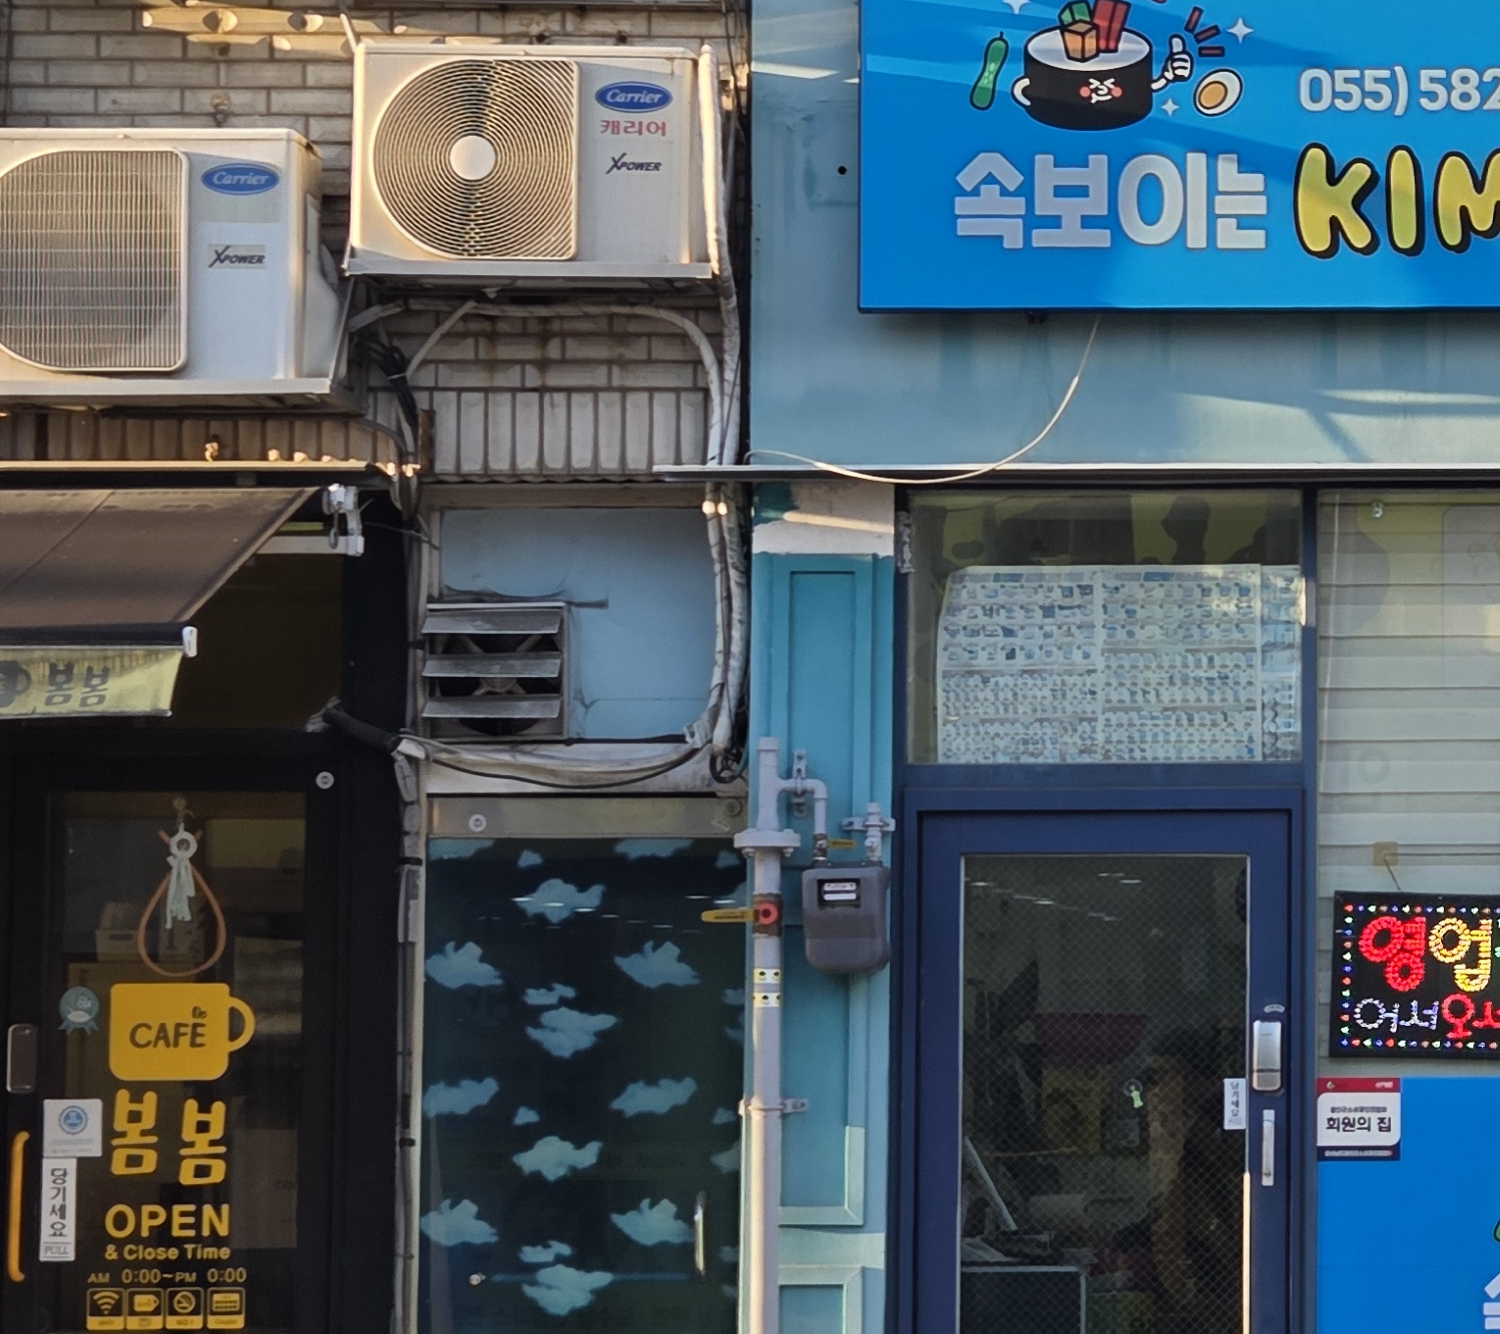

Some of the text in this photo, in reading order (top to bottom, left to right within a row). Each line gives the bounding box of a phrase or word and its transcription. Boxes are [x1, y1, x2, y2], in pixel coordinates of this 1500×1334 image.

[606, 89, 663, 104] Carrier
[600, 119, 667, 137] 캐리어
[212, 171, 270, 185] Carrier
[953, 151, 1268, 250] 속보이는
[44, 662, 110, 707] 봄봄
[1325, 1116, 1392, 1133] 회원의 집
[111, 1088, 232, 1186] 봄봄
[49, 1168, 68, 1238] 당기세요
[105, 1204, 230, 1238] OPEN
[44, 1244, 71, 1257] PULL
[105, 1244, 231, 1261] & Close Time
[88, 1272, 111, 1284] AM
[207, 1267, 247, 1283] 0:00
